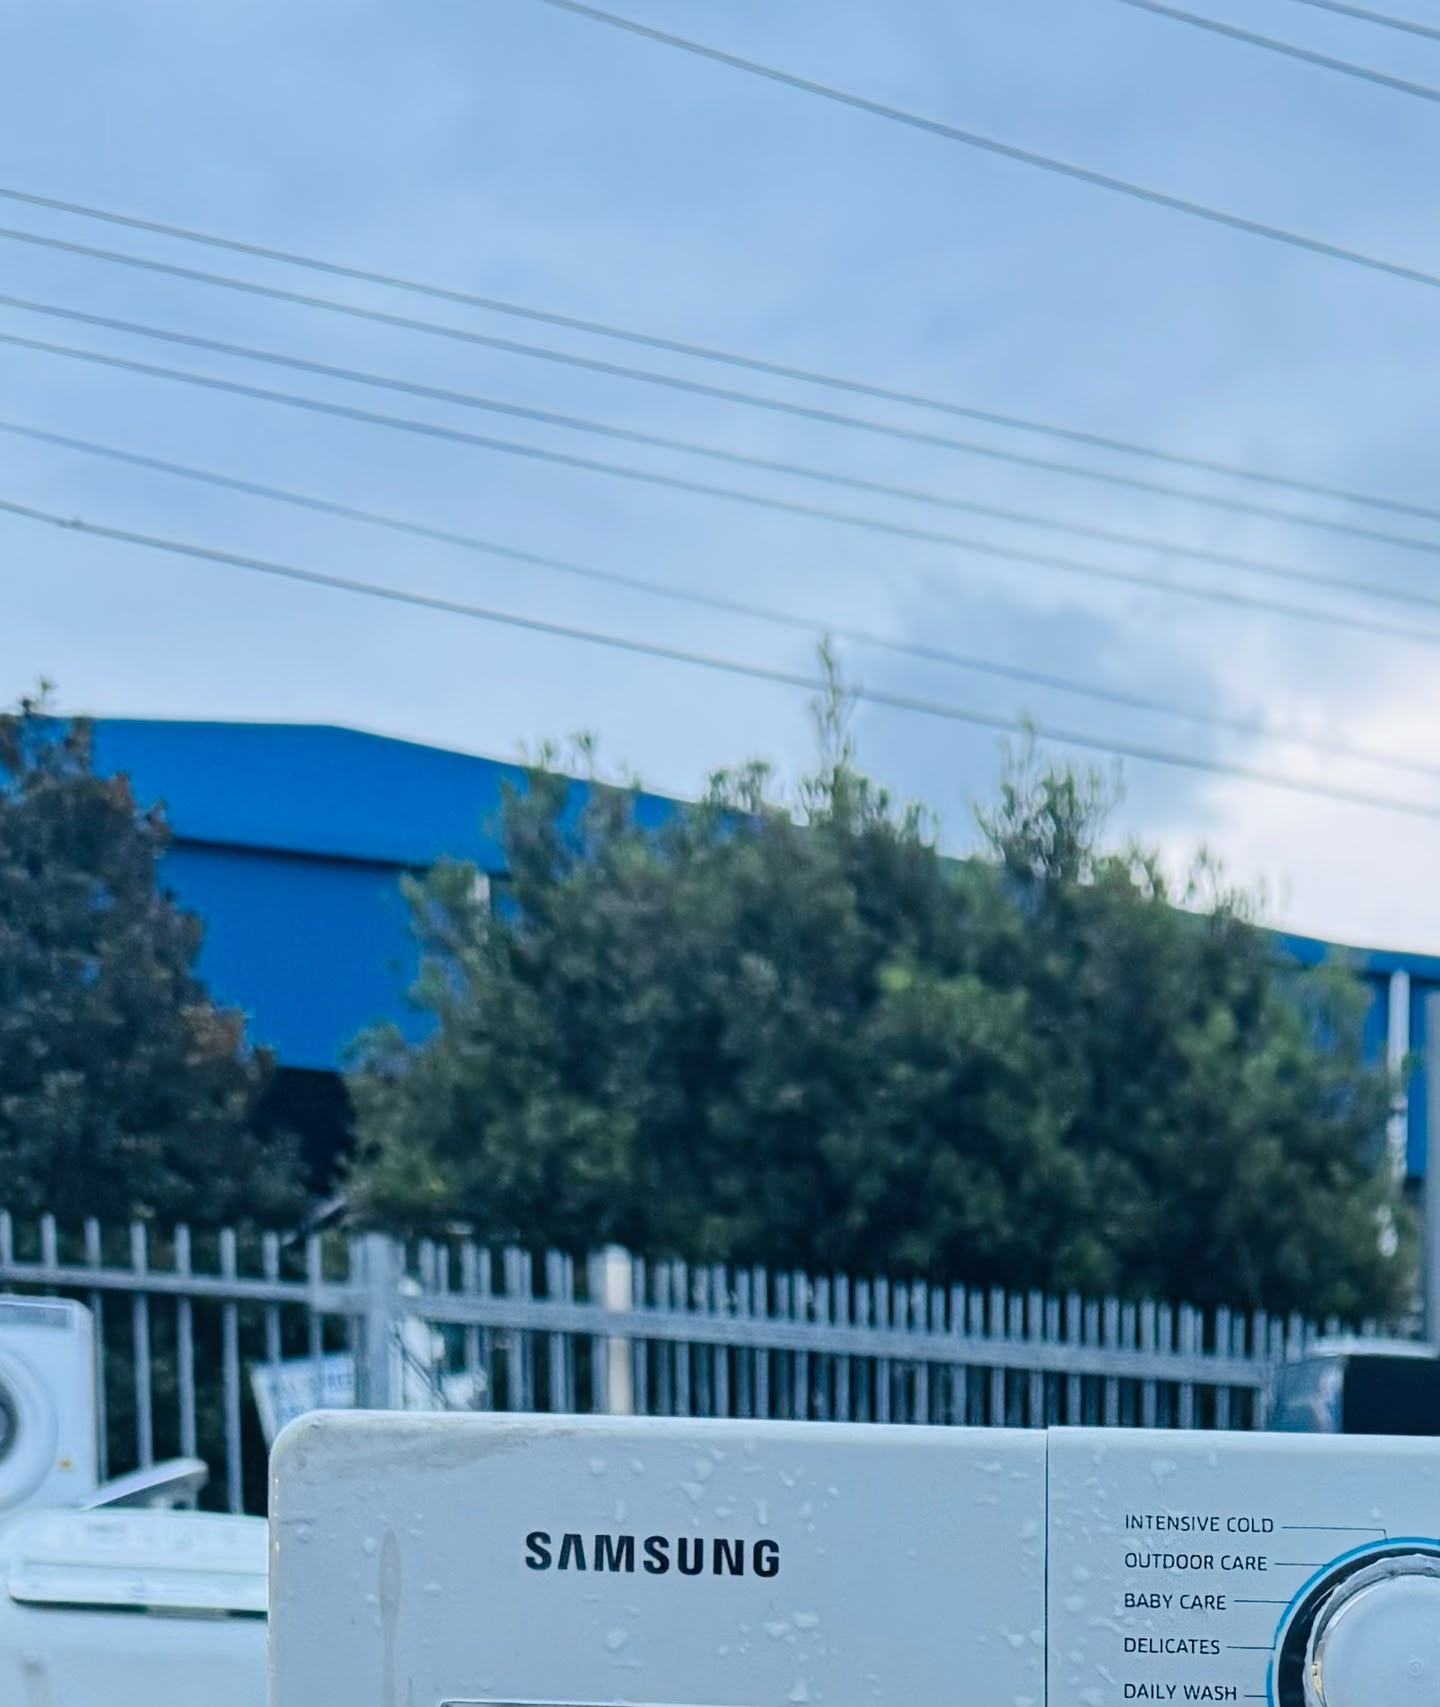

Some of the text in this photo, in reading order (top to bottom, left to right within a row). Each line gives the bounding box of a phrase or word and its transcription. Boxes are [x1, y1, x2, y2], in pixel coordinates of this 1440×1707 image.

[1124, 1513, 1275, 1534] INTENSIVE COLD
[524, 1531, 780, 1578] SAMSUNG
[1124, 1551, 1268, 1572] OUTDOOR CARE
[1124, 1592, 1227, 1612] BABY CARE
[1123, 1636, 1221, 1656] DELICATES
[1123, 1682, 1238, 1702] DAILY WASH
